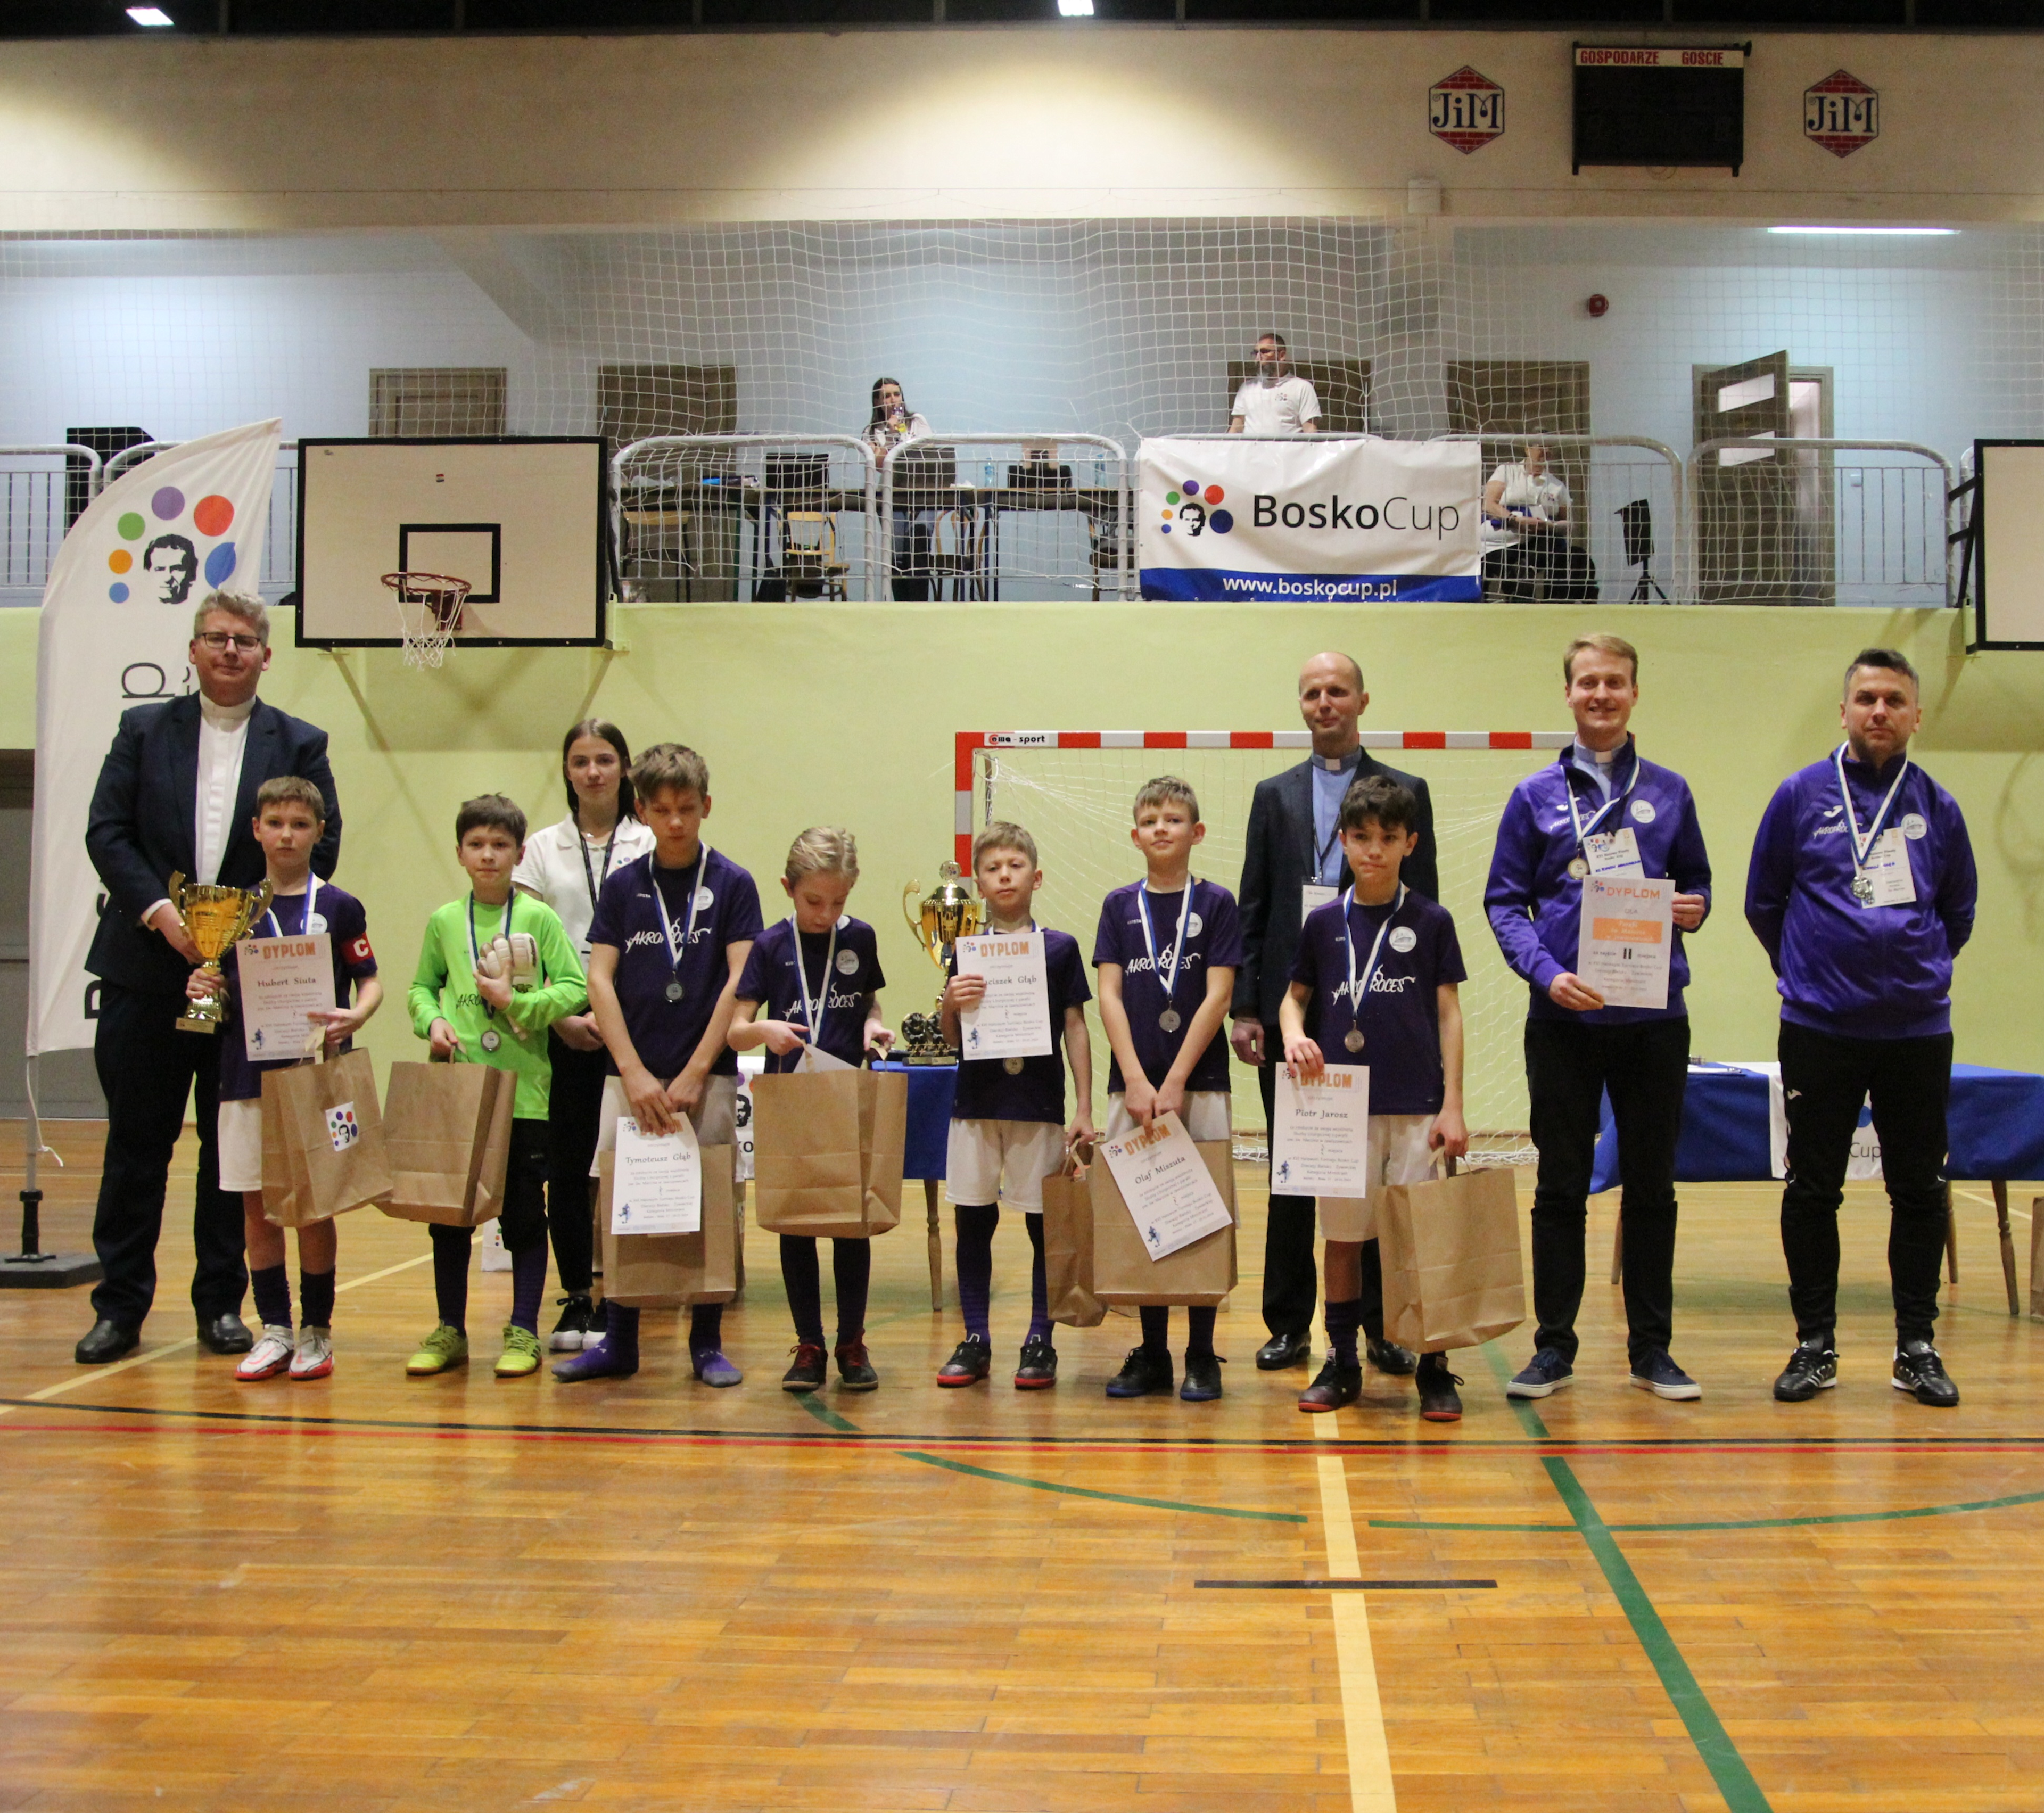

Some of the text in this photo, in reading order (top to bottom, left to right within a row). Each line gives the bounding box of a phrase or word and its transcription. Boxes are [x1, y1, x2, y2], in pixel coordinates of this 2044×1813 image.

[1580, 50, 1659, 64] GOSPODARZE
[1432, 93, 1501, 128] JiM
[1808, 96, 1875, 132] JiM
[1223, 578, 1397, 600] www.boskocup.pl
[1019, 735, 1045, 744] sport
[1606, 887, 1660, 899] DYPLOM
[262, 942, 316, 959] DYPLOM
[353, 938, 369, 957] C
[980, 941, 1029, 957] DYPLOM
[258, 978, 289, 987] Hubert
[985, 975, 1037, 985] ciszek Głąb
[1320, 1109, 1348, 1119] Jarosz
[625, 1156, 667, 1166] Tymoteusz
[1135, 1171, 1152, 1184] Olaf
[1155, 1156, 1186, 1174] Miszuta
